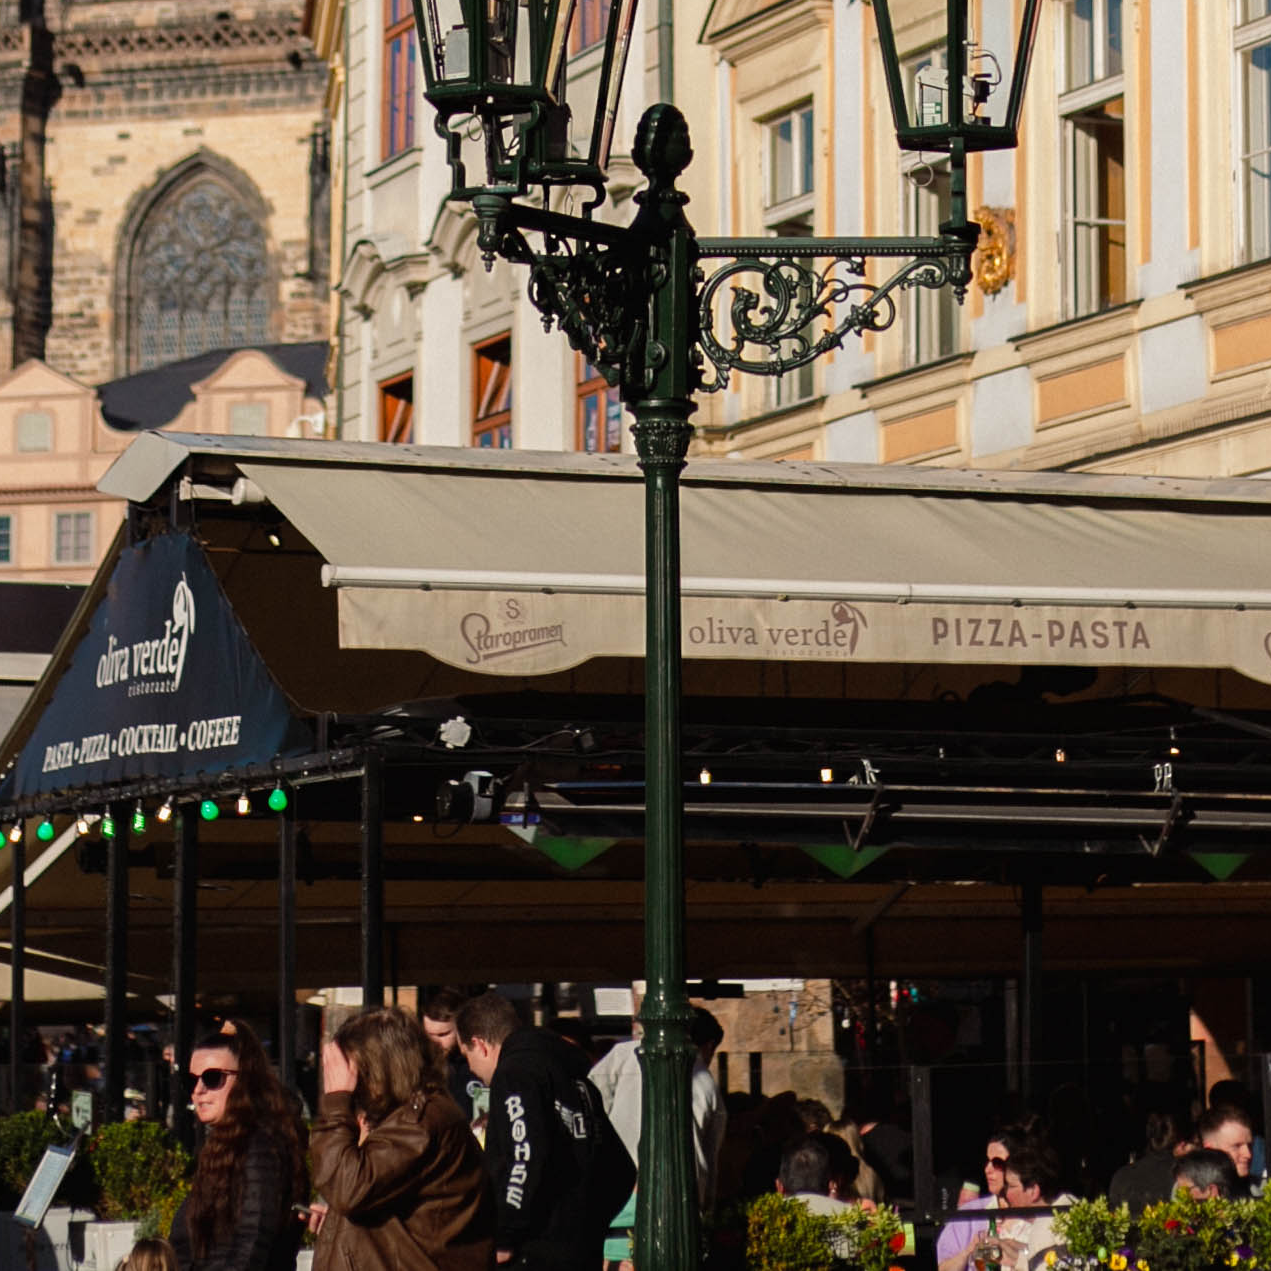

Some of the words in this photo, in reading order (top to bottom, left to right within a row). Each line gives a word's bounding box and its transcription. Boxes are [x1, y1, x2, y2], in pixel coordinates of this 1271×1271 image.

[96, 634, 130, 689] oliva
[133, 619, 180, 677] verde
[460, 612, 568, 664] Staropramen
[688, 616, 759, 645] oliva
[767, 619, 849, 648] verde
[931, 617, 1151, 650] PIZZA-PASTA
[42, 741, 74, 773] PASTA
[78, 733, 110, 765] PIZZA
[117, 723, 179, 757] COCKTAIL
[187, 715, 242, 751] COFFEE
